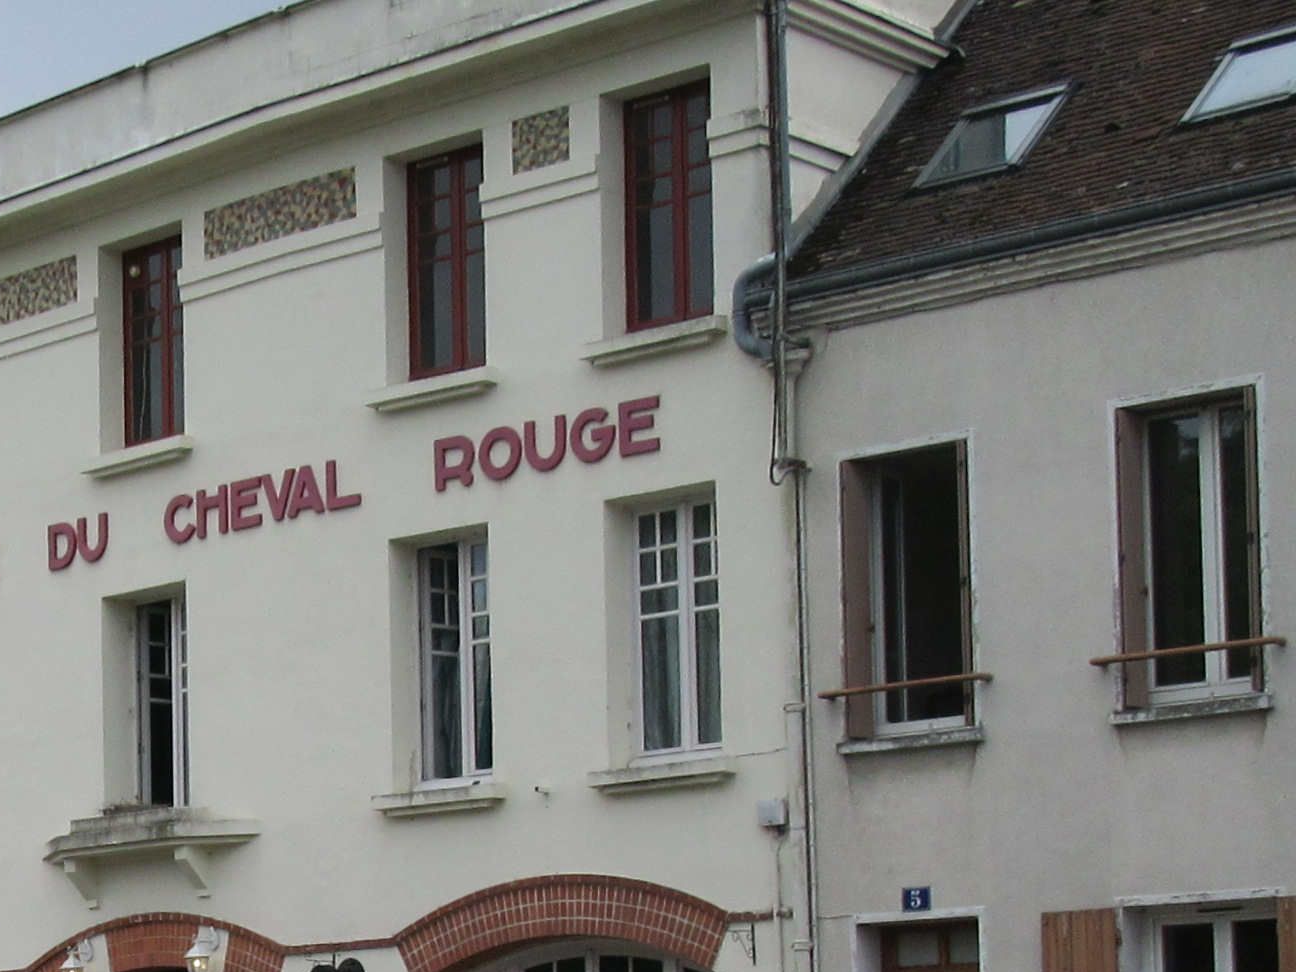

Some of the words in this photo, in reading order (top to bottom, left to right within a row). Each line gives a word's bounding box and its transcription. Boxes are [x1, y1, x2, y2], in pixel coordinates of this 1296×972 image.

[47, 512, 109, 572] DU
[164, 460, 362, 544] CHEVAL
[434, 395, 660, 493] ROUGE
[910, 889, 921, 908] 5
